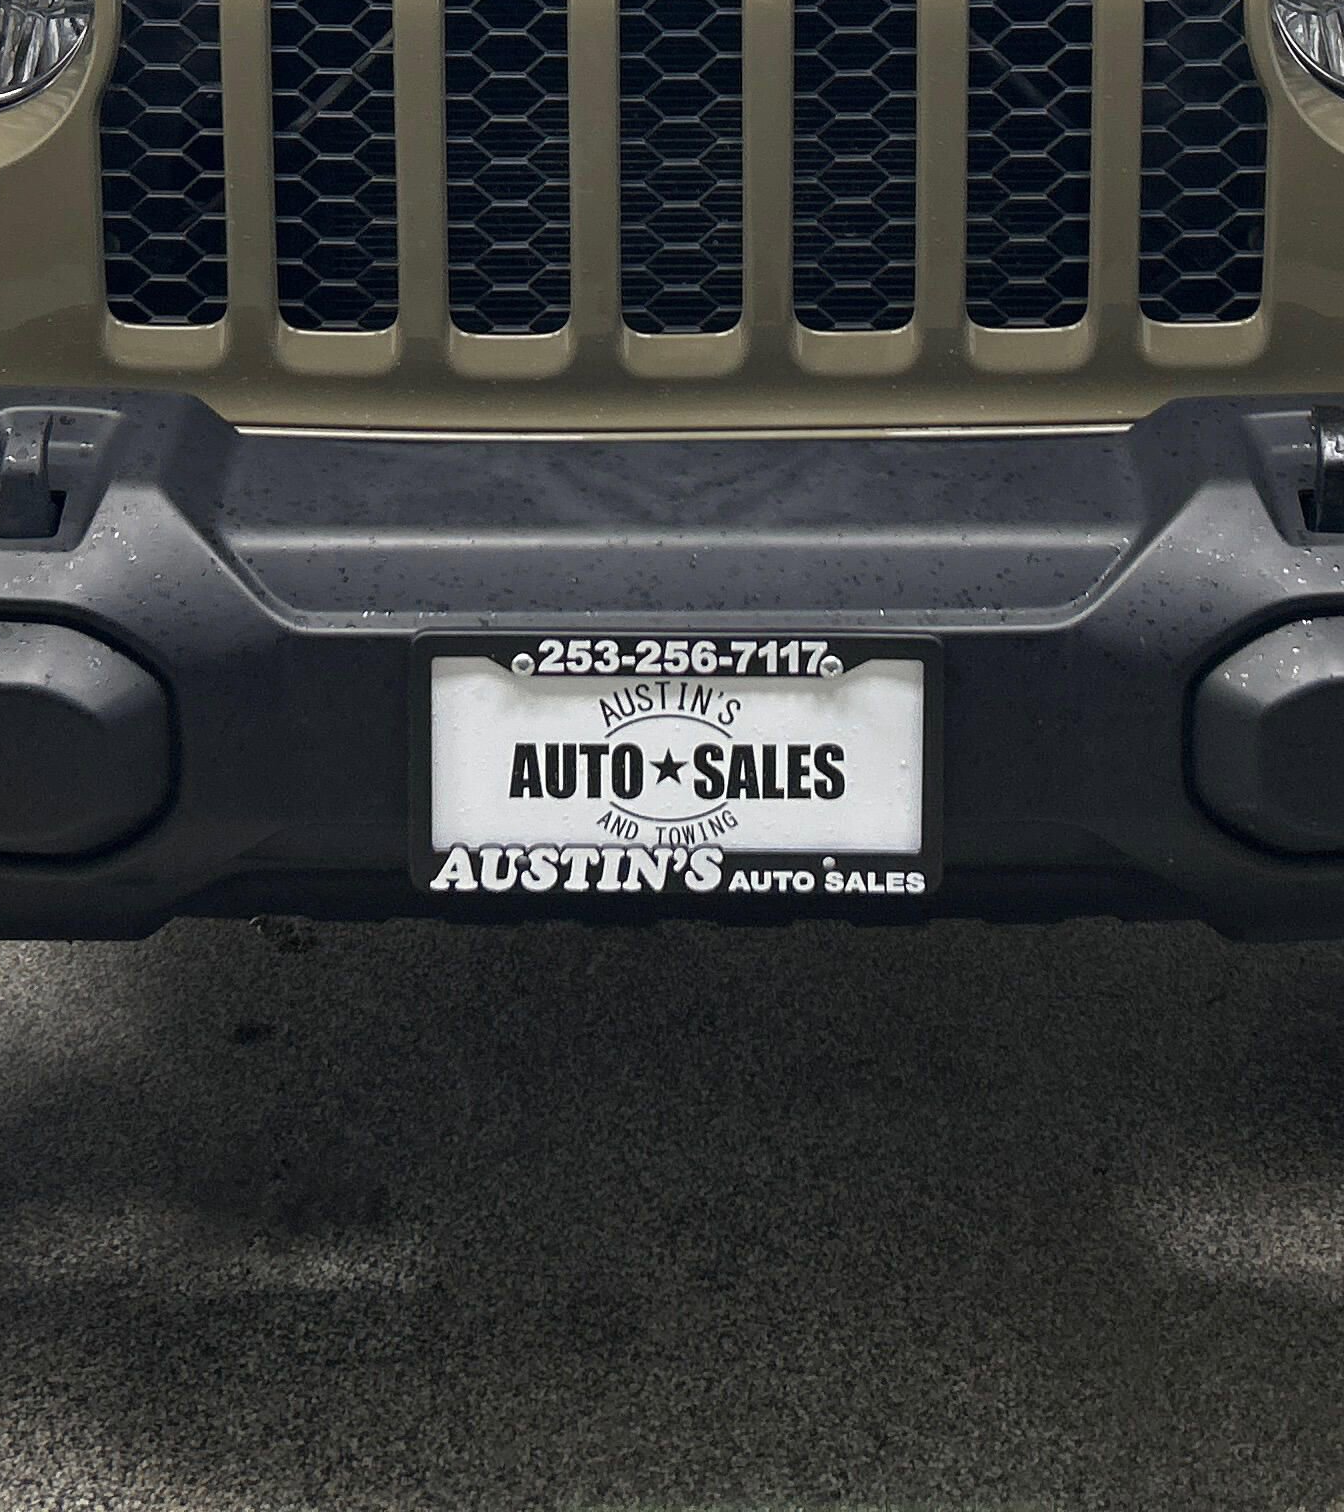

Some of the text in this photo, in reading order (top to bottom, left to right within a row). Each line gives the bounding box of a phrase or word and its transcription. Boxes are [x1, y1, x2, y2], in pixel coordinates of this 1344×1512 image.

[537, 639, 828, 675] 253-256-7117
[598, 680, 742, 728] AUSTIN'S
[509, 742, 846, 800] AUTO SALES
[596, 809, 739, 846] AND TOWING
[430, 845, 927, 894] AUSTIN'S AUTO SALES
